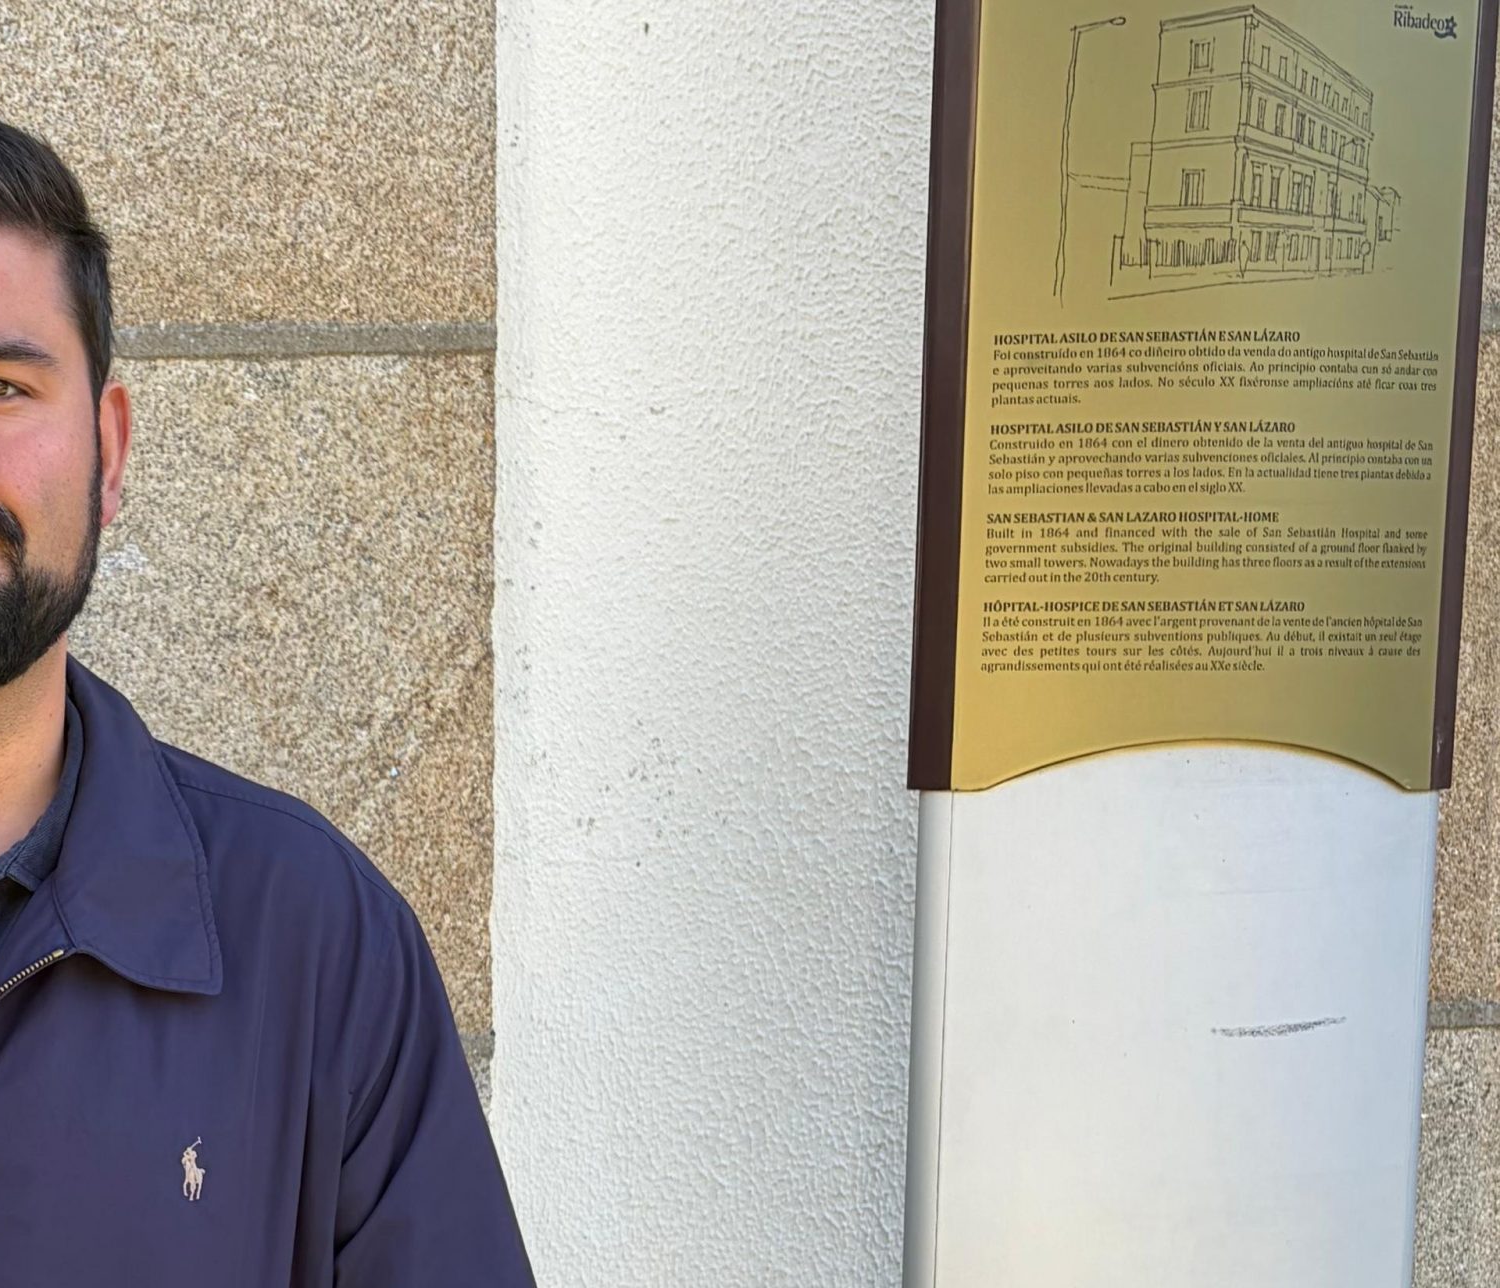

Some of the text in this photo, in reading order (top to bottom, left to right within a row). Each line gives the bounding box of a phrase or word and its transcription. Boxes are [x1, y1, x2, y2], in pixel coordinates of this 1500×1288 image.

[1393, 10, 1445, 31] Ribadeo
[994, 334, 1058, 345] HOSPITAL
[1059, 333, 1098, 344] ASILO
[1099, 333, 1117, 343] DE
[1119, 333, 1144, 343] SAN
[1146, 329, 1217, 342] SEBASTIÁN
[1227, 332, 1252, 341] SAN
[1253, 329, 1300, 341] LÁZARO
[993, 349, 1011, 360] Foi
[1079, 351, 1094, 359] en
[1097, 348, 1126, 358] 1864
[1128, 350, 1143, 358] co
[1086, 363, 1123, 374] varias
[992, 382, 1049, 392] pequenas
[1053, 379, 1090, 389] torres
[1157, 377, 1174, 388] No
[991, 394, 1035, 408] plantas
[990, 424, 1054, 435] HOSPITAL
[1055, 424, 1094, 434] ASILO
[1095, 423, 1113, 433] DE
[1114, 423, 1140, 433] SAN
[1141, 419, 1212, 433] SEBASTIÁN
[1223, 422, 1247, 432] SAN
[1249, 419, 1295, 432] LÁZARO
[1058, 441, 1074, 449] en
[1079, 438, 1108, 449] 1864
[1136, 437, 1147, 448] el
[1151, 437, 1190, 448] dinero
[1144, 453, 1180, 463] varias
[988, 468, 1013, 479] solo
[1015, 469, 1040, 482] piso
[1042, 471, 1064, 479] con
[1126, 468, 1162, 478] torres
[1173, 467, 1190, 478] los
[988, 483, 1004, 494] las
[1085, 482, 1133, 493] llevadas
[1143, 482, 1171, 493] cabo
[1172, 485, 1187, 493] en
[1188, 482, 1199, 493] el
[986, 514, 1012, 524] SAN
[1013, 513, 1085, 524] SEBASTIAN
[1099, 513, 1124, 523] SAN
[1126, 512, 1177, 522] LAZARO
[1178, 512, 1279, 522] HOSPITAL-HOME
[986, 528, 1015, 538] Built
[1021, 528, 1033, 538] in
[1040, 527, 1069, 538] 1864
[1075, 527, 1099, 538] and
[1104, 527, 1156, 538] financed
[1161, 526, 1188, 537] with
[1122, 542, 1145, 553] The
[1148, 542, 1193, 555] original
[985, 558, 1008, 568] two
[1009, 557, 1041, 568] small
[1089, 557, 1150, 570] Nowadays
[1151, 556, 1171, 567] the
[1172, 556, 1220, 570] building
[984, 572, 1027, 582] carried
[1028, 573, 1048, 582] out
[1049, 572, 1061, 582] in
[1063, 572, 1082, 582] the
[1084, 571, 1111, 582] 20th
[983, 598, 1305, 612] HÔPITAL-HOSPICE DE SAN SEBASTIÁN ET SAN LÁZARO
[983, 616, 991, 626] Il
[1021, 617, 1076, 626] construit
[1095, 616, 1124, 626] 1864
[1153, 616, 1197, 629] l'argent
[1042, 633, 1054, 641] et
[1057, 631, 1072, 641] de
[1076, 630, 1131, 644] plusieurs
[981, 648, 1008, 656] avec
[1013, 645, 1034, 656] des
[1039, 646, 1080, 659] petites
[1086, 646, 1117, 656] tours
[1122, 648, 1143, 656] sur
[1148, 645, 1164, 656] les
[1081, 661, 1101, 674] qui
[1102, 661, 1122, 671] ont
